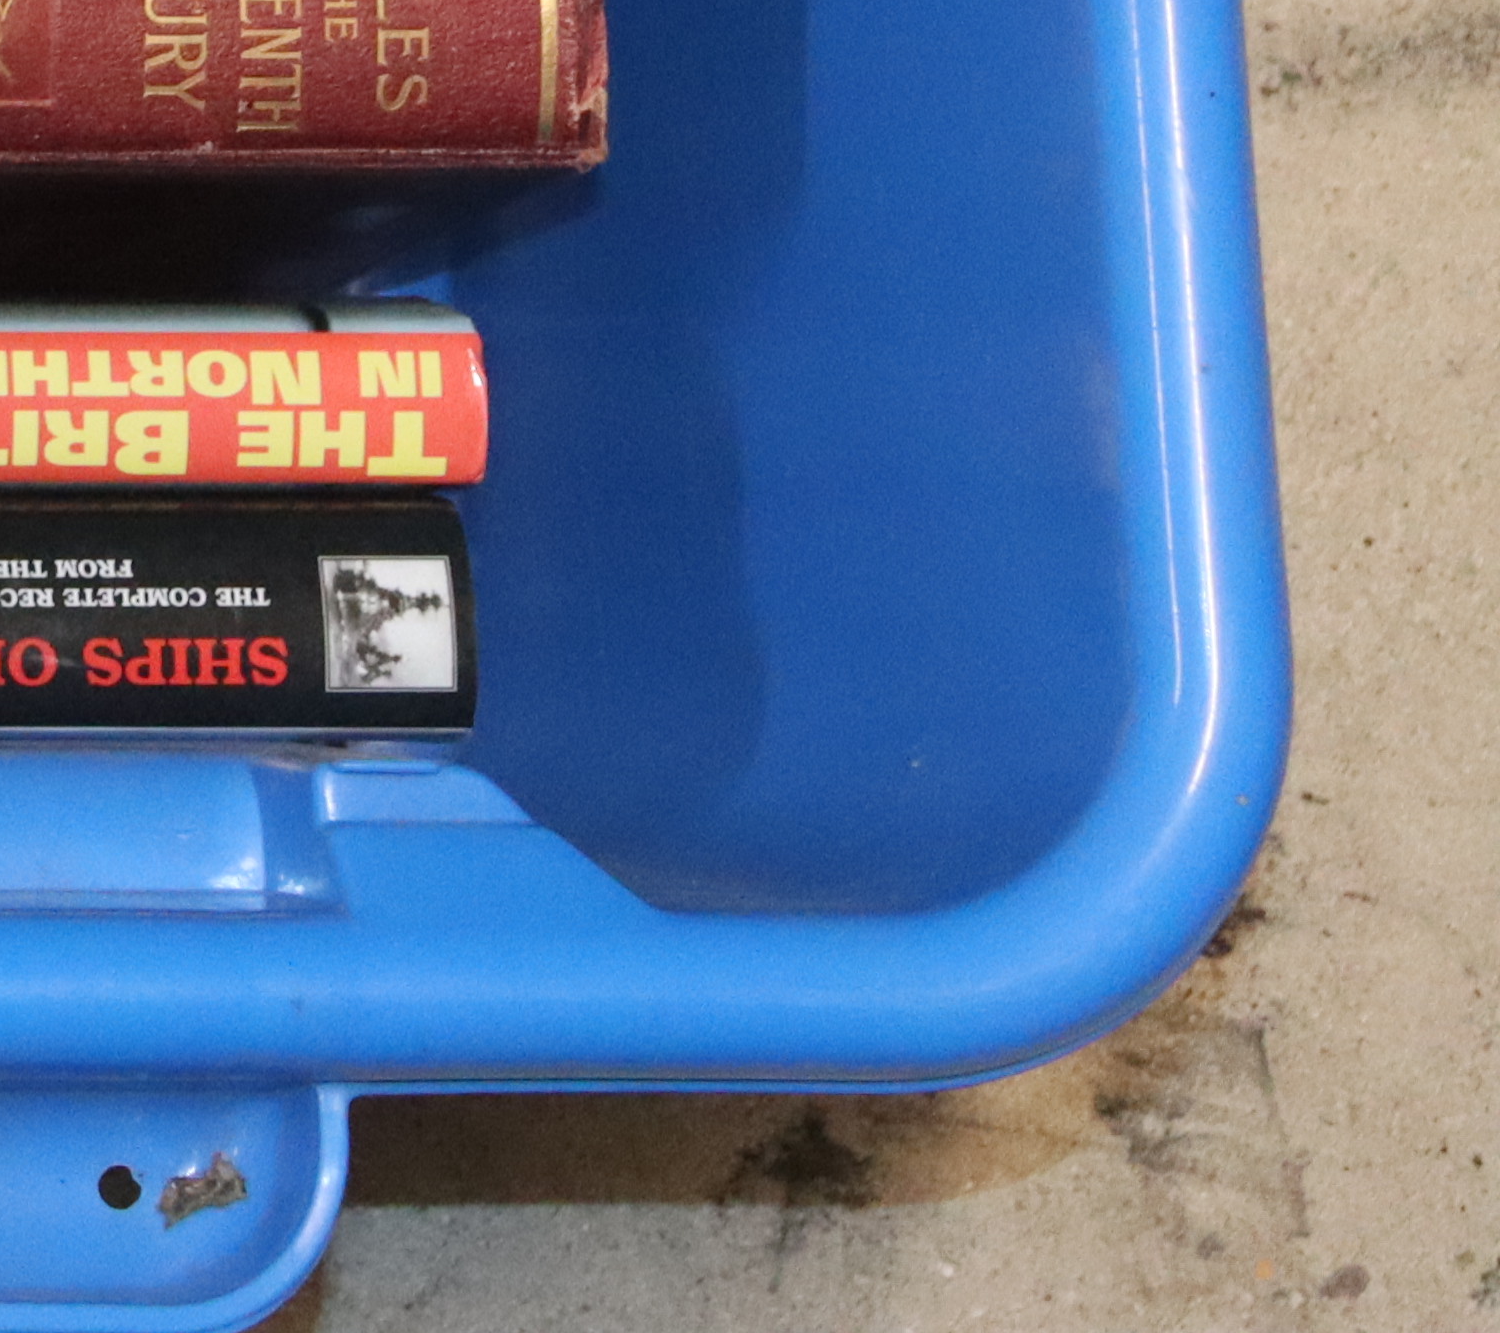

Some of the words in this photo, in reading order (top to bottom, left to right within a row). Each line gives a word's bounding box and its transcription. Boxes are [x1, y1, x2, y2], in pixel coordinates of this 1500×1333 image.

[360, 352, 441, 396] IN
[239, 412, 445, 474] THE
[56, 561, 132, 577] FROM
[64, 588, 206, 606] COMPLETE
[216, 588, 270, 606] THE
[84, 638, 286, 684] SHIPS
